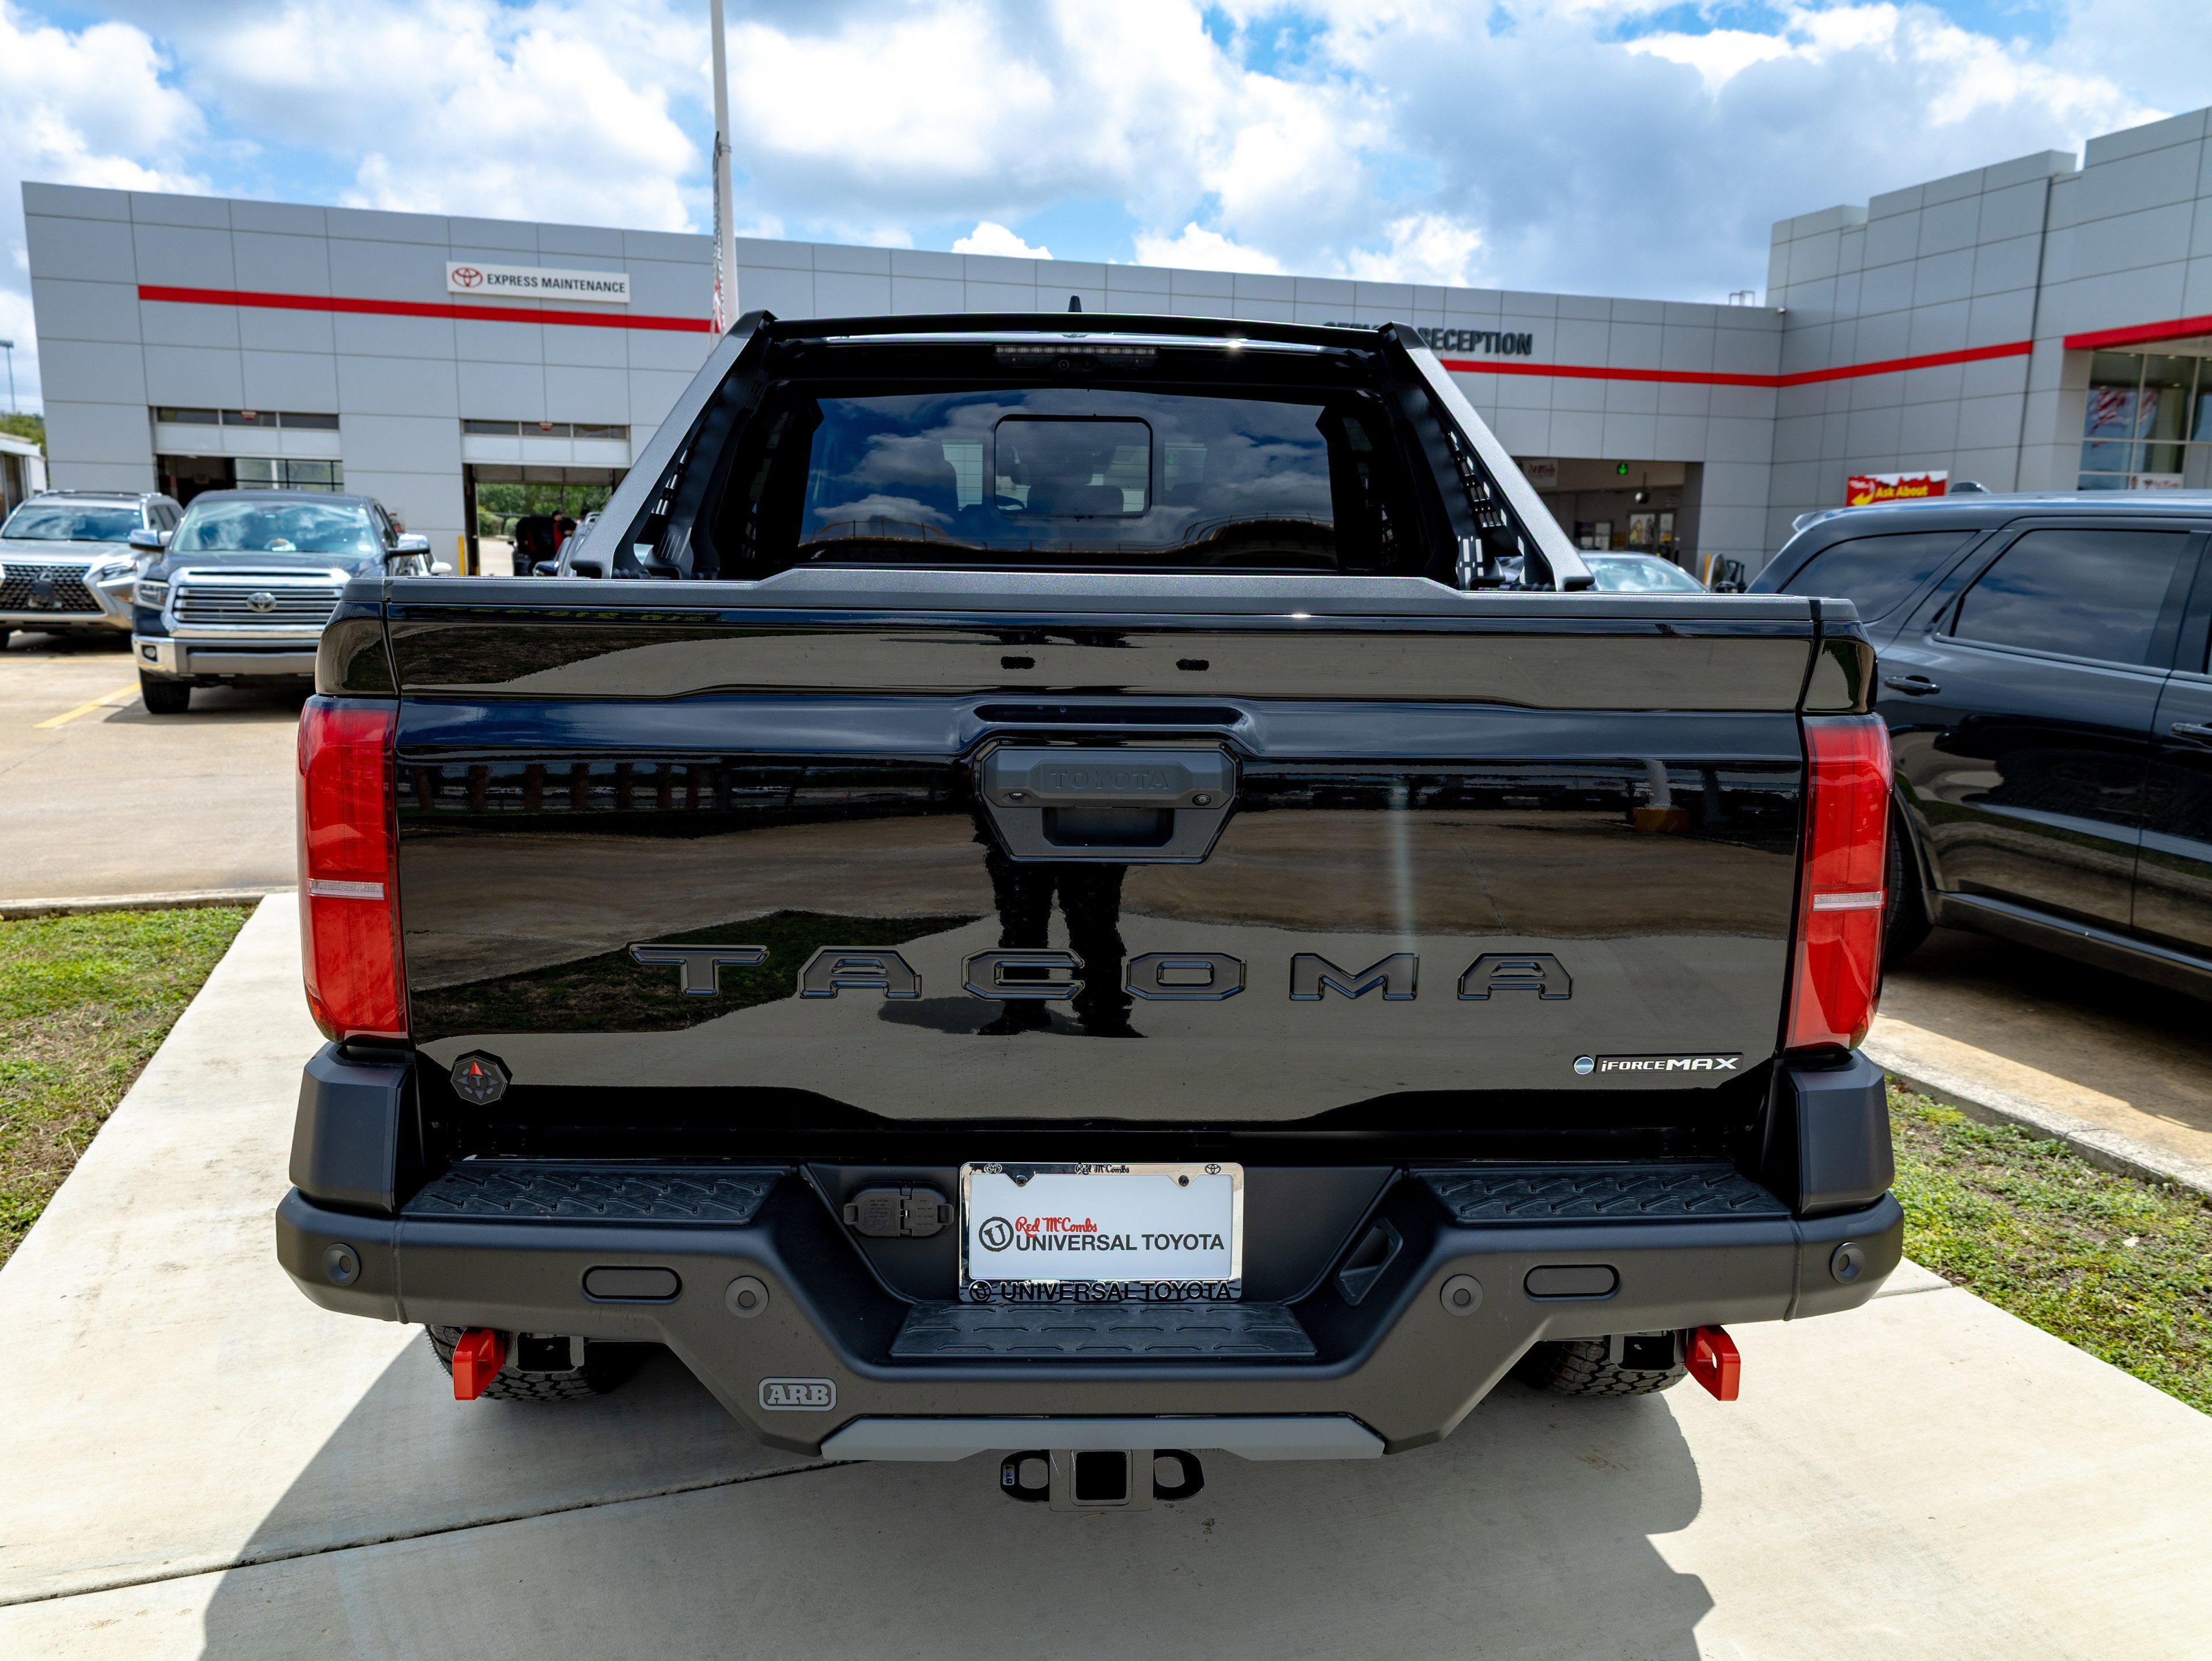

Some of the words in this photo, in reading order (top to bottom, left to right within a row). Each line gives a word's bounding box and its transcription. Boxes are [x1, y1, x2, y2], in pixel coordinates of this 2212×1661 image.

[487, 273, 538, 287] EXPRESS
[541, 277, 626, 293] MAINTENANCE
[1416, 327, 1533, 355] RECEPTION
[1050, 768, 1169, 790] TOYOTA
[628, 943, 1574, 1002] TACOMA
[1075, 1163, 1092, 1175] Red
[1093, 1164, 1130, 1174] McCombs
[1015, 1216, 1040, 1238] Red
[1041, 1216, 1097, 1233] McCombs
[1016, 1234, 1137, 1251] UNIVERSAL
[1141, 1234, 1225, 1251] TOYOTA
[1000, 1281, 1138, 1301] UNIVERSAL
[1140, 1280, 1232, 1301] TOYOTA
[767, 1384, 829, 1405] ARB
